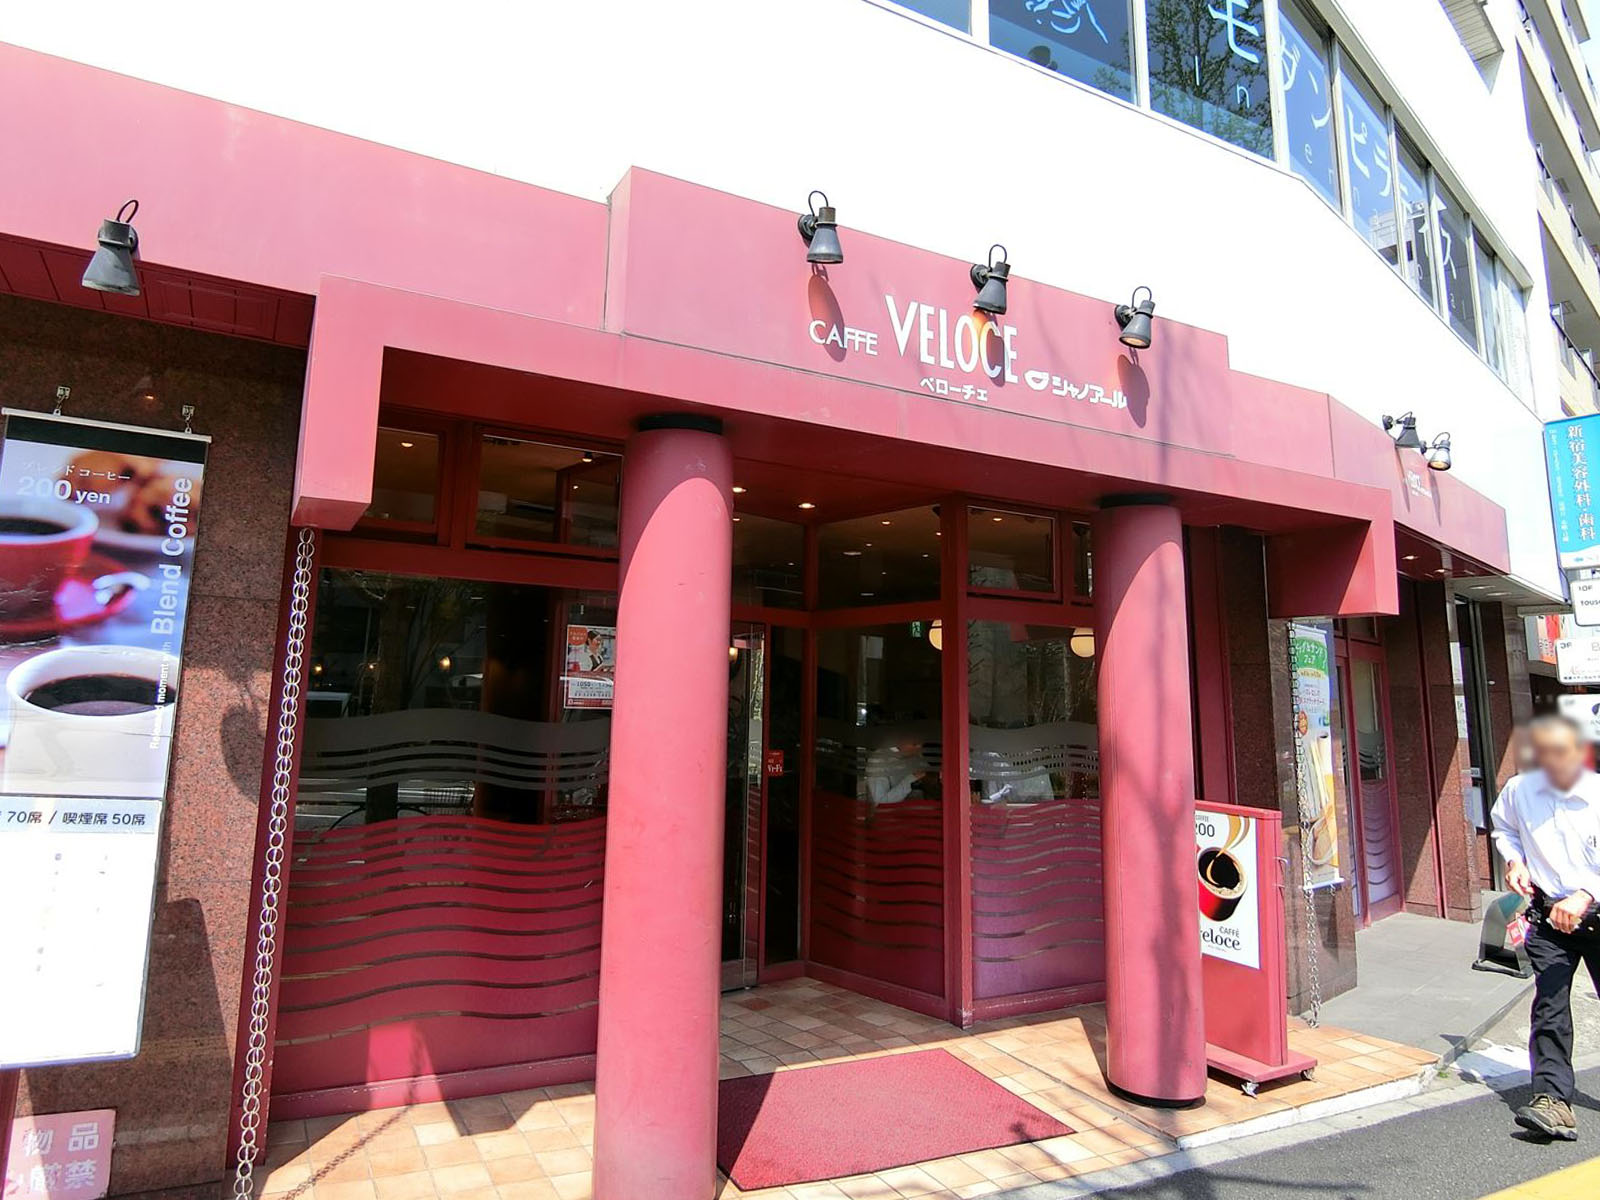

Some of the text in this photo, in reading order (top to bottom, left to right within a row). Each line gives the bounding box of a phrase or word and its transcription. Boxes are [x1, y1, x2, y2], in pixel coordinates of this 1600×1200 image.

[808, 294, 1019, 384] CAFFE VELOCE
[920, 374, 1127, 409] ベローチェ シャノアール
[16, 476, 111, 504] 200 yen
[161, 478, 192, 557] Coffee
[151, 563, 183, 636] Blend
[157, 664, 169, 704] moment
[112, 813, 146, 826] 50席
[1200, 928, 1242, 951] eloce
[22, 1122, 99, 1157] 物品
